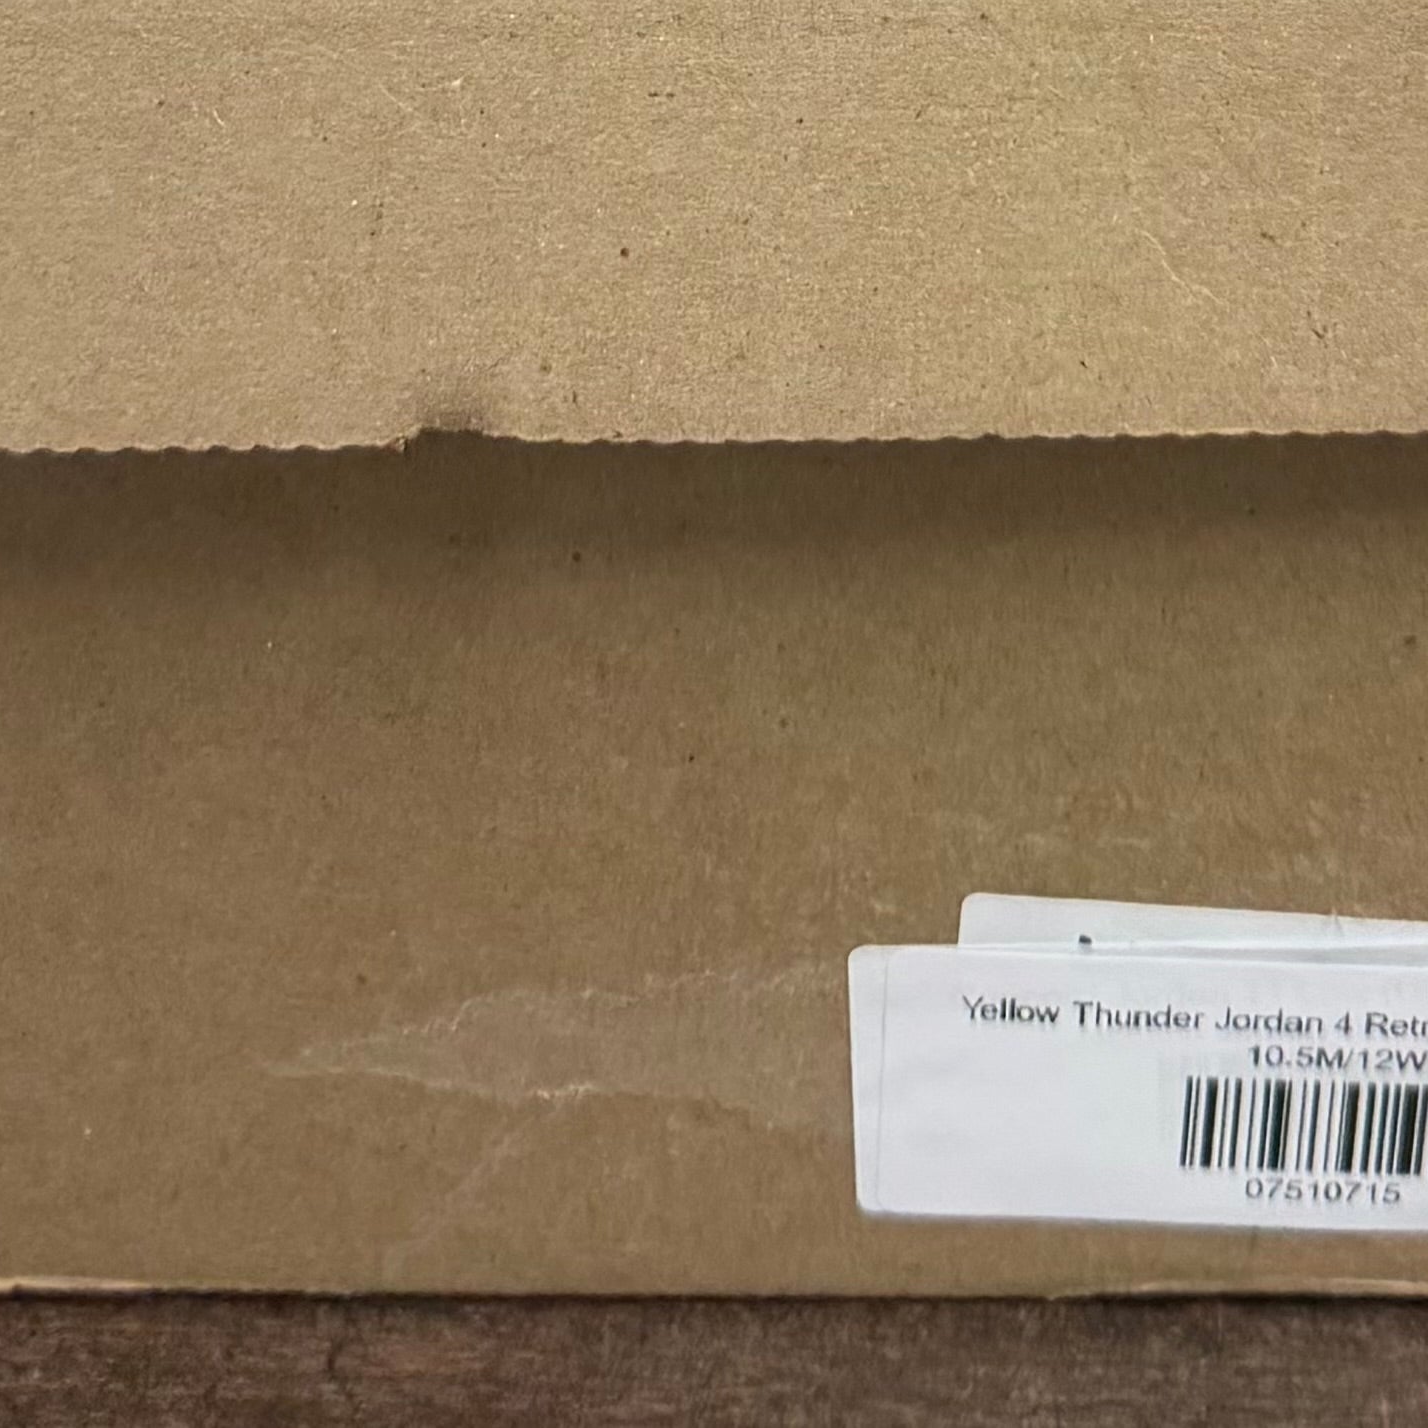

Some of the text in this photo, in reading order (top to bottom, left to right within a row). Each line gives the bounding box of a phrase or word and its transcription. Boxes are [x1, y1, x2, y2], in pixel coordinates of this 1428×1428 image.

[962, 995, 1060, 1024] Yellow
[1073, 1000, 1206, 1030] Thunder
[1215, 1006, 1323, 1034] Jordan
[1334, 1011, 1352, 1034] 4
[1248, 1045, 1428, 1072] 10.5M/12W
[1244, 1177, 1401, 1204] 07510715
